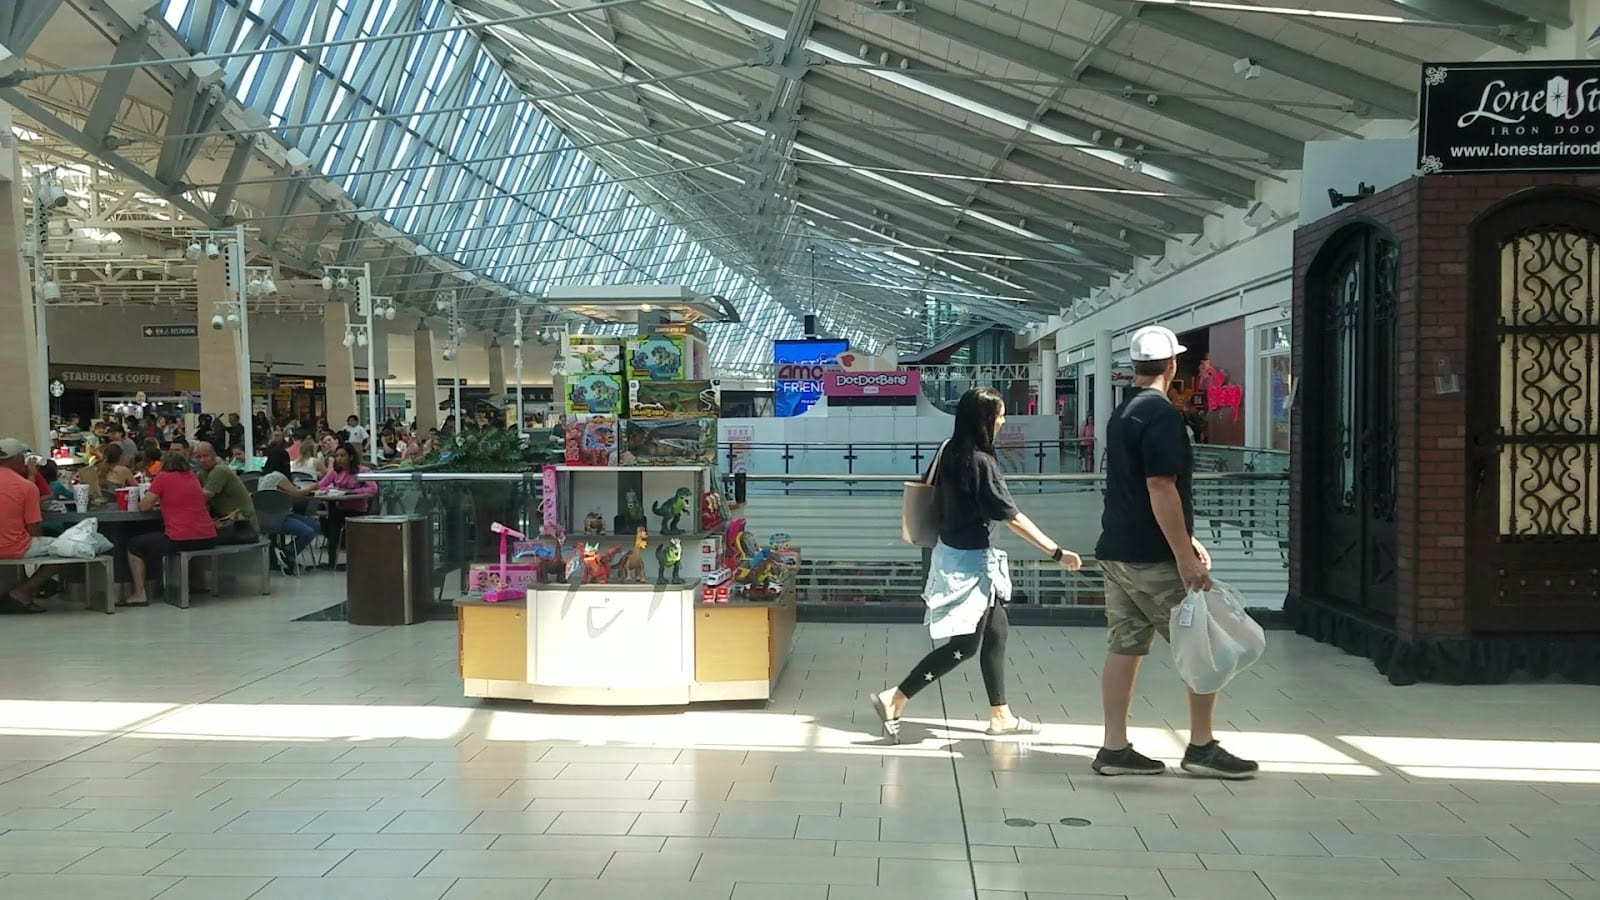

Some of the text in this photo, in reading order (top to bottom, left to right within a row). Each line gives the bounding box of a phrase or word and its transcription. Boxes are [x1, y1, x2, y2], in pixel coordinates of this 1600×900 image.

[1457, 80, 1547, 128] Lone
[1491, 125, 1595, 136] IRON DOO
[62, 371, 161, 384] STARBUCKS COFFEE
